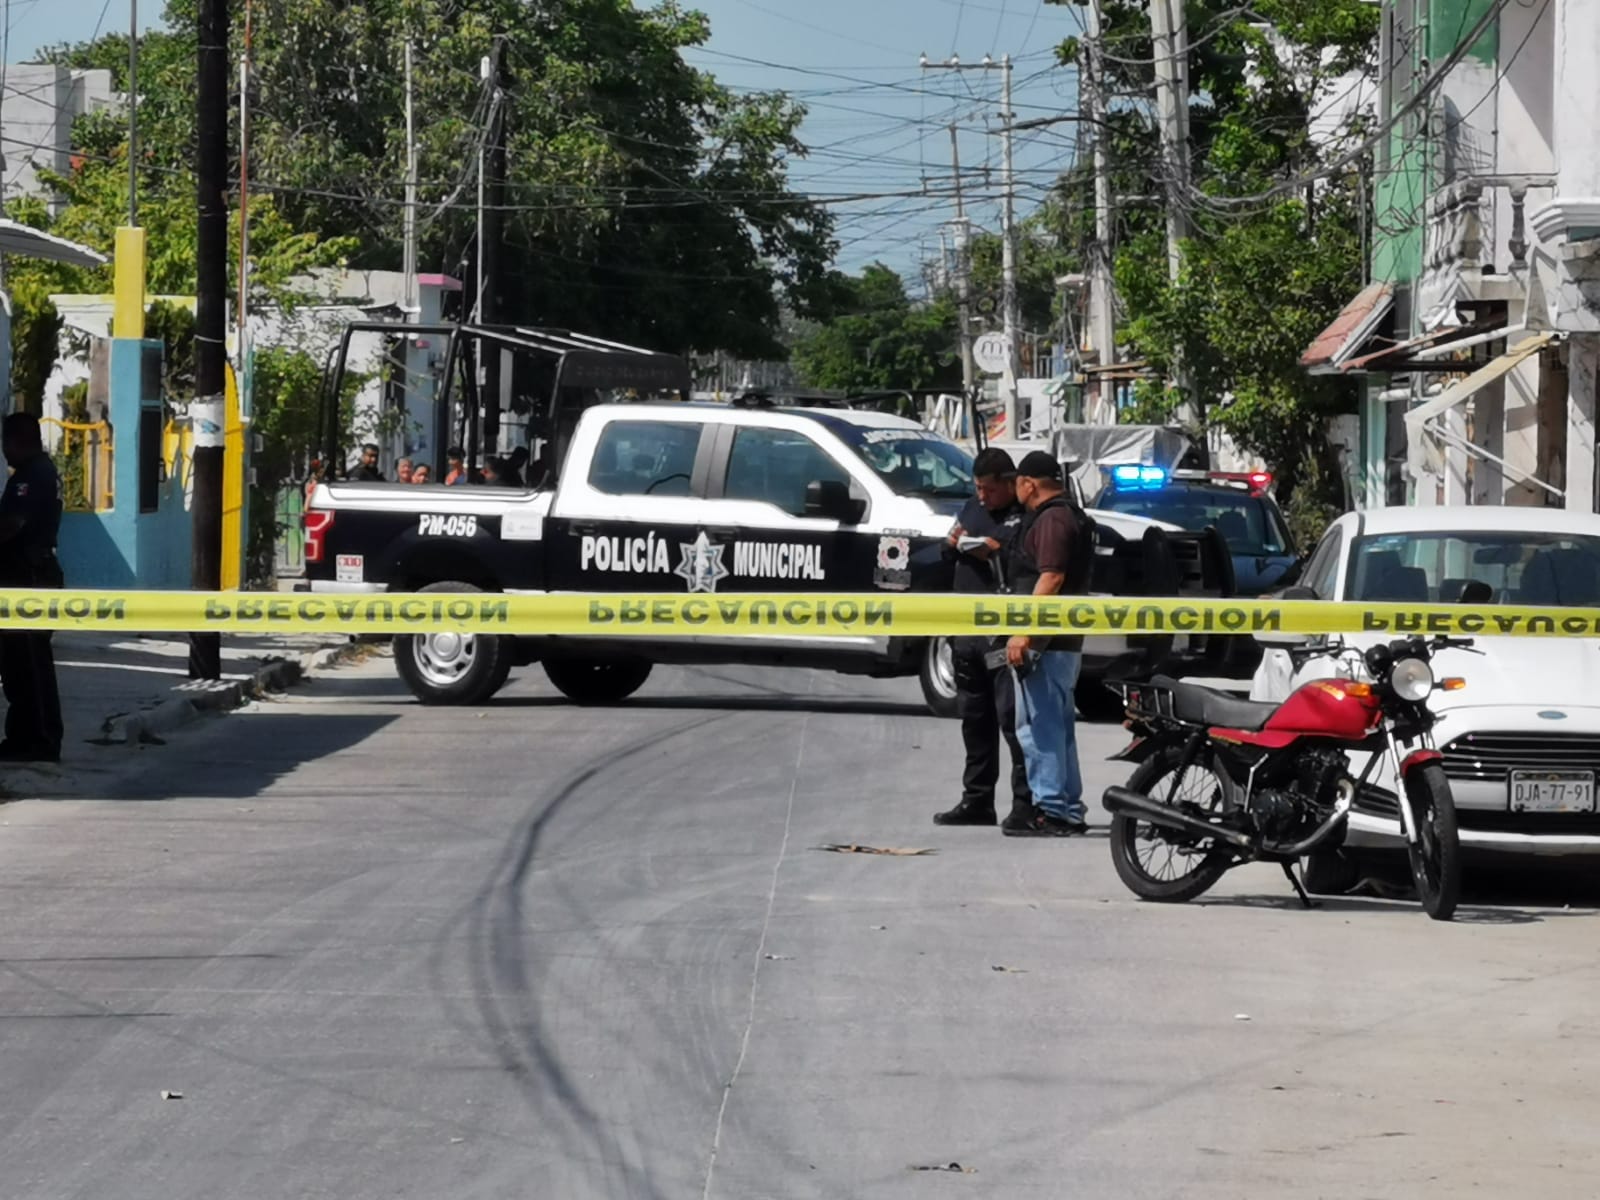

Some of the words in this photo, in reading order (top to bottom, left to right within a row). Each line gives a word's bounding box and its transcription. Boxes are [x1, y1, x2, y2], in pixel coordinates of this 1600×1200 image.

[418, 514, 477, 537] PM-056
[581, 530, 670, 573] POLICÍA
[733, 541, 825, 580] MUNICIPAL
[1515, 784, 1590, 801] DJA-77-91
